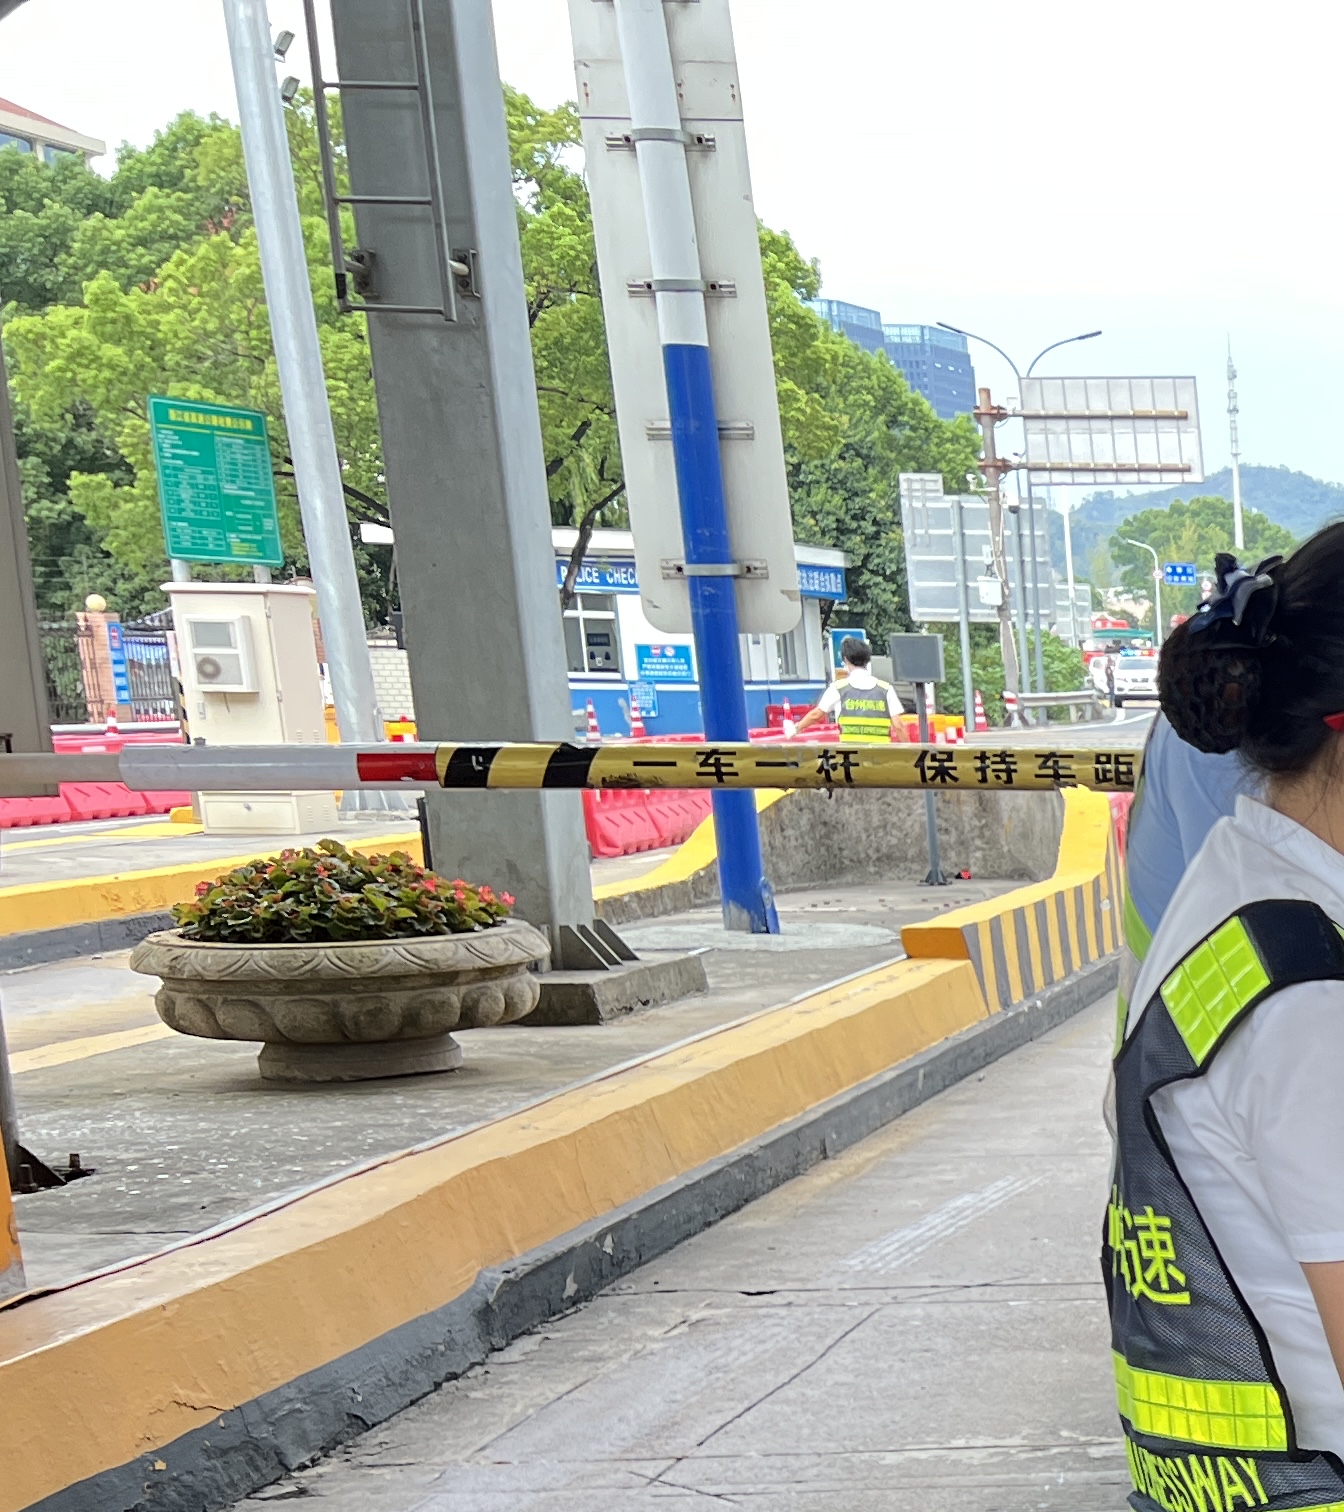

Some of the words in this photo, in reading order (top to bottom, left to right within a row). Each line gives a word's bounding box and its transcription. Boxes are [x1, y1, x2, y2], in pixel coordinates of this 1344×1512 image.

[632, 748, 861, 784] 一车一杆
[913, 750, 1136, 785] 保持车距
